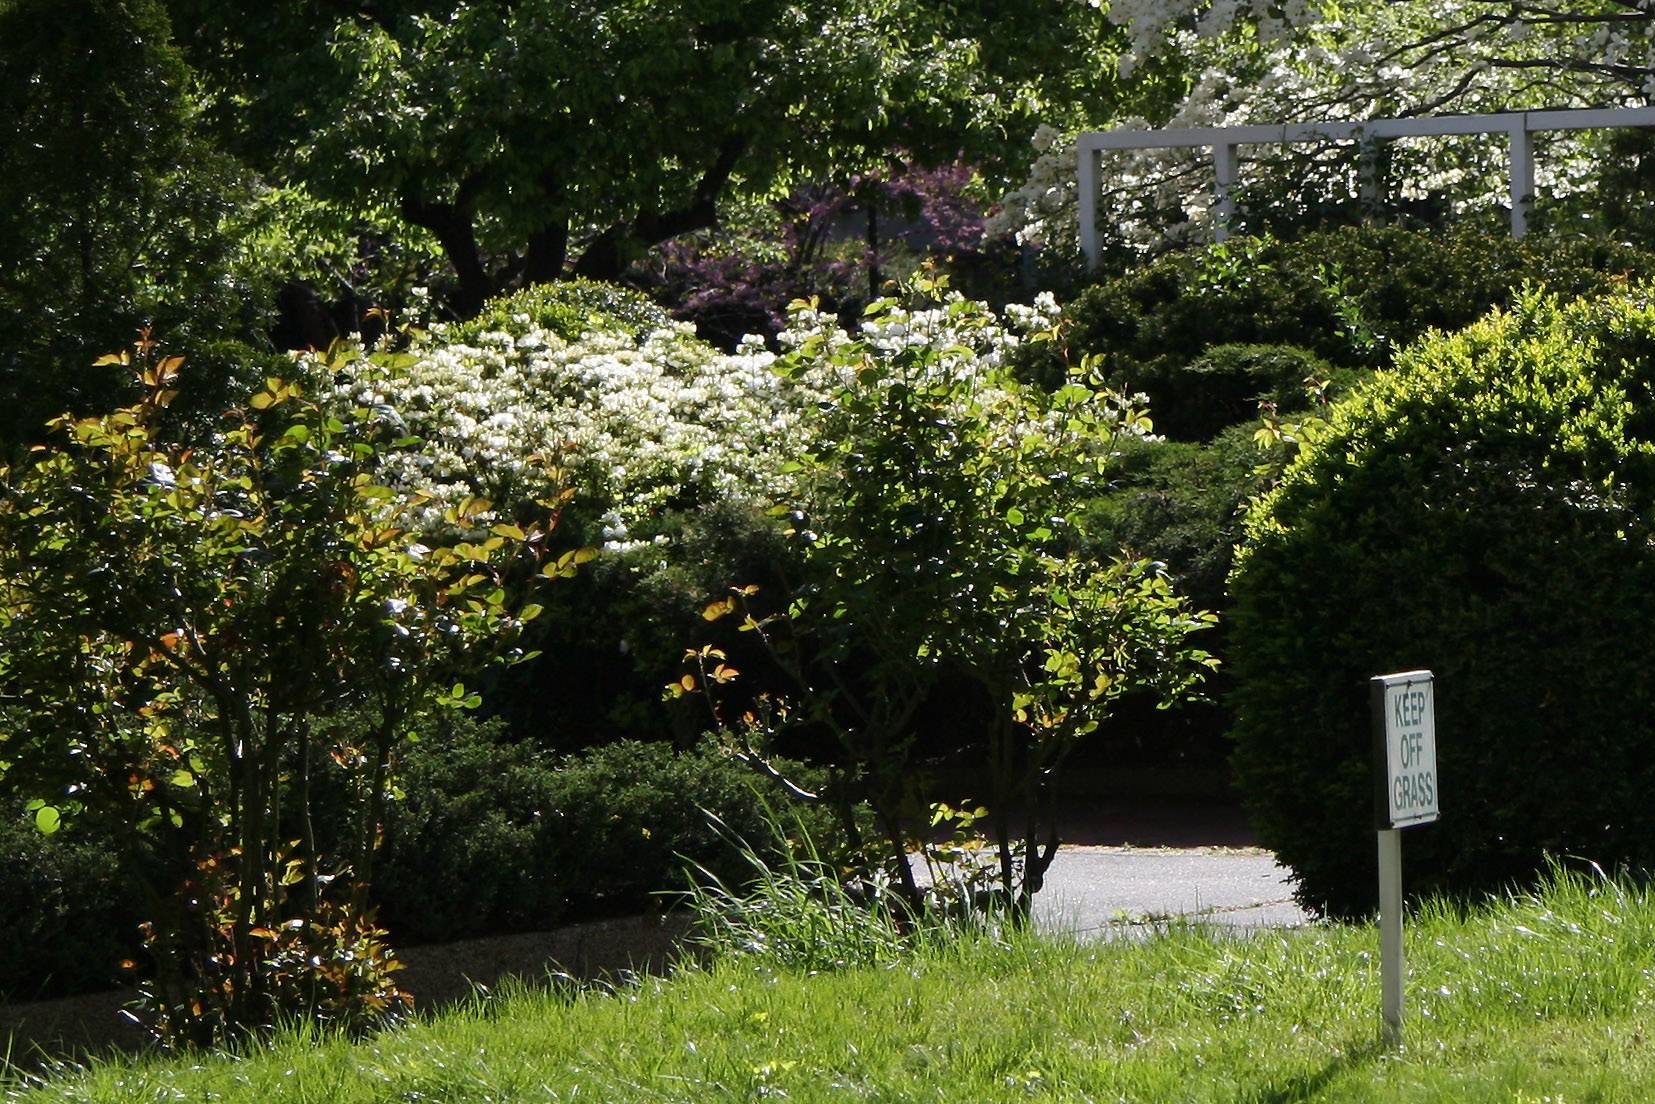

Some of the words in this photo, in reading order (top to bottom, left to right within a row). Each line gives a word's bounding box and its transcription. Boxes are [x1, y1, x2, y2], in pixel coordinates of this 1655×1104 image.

[1394, 692, 1425, 728] KEEP
[1400, 732, 1423, 769] OFF
[1393, 772, 1433, 810] GRASS
